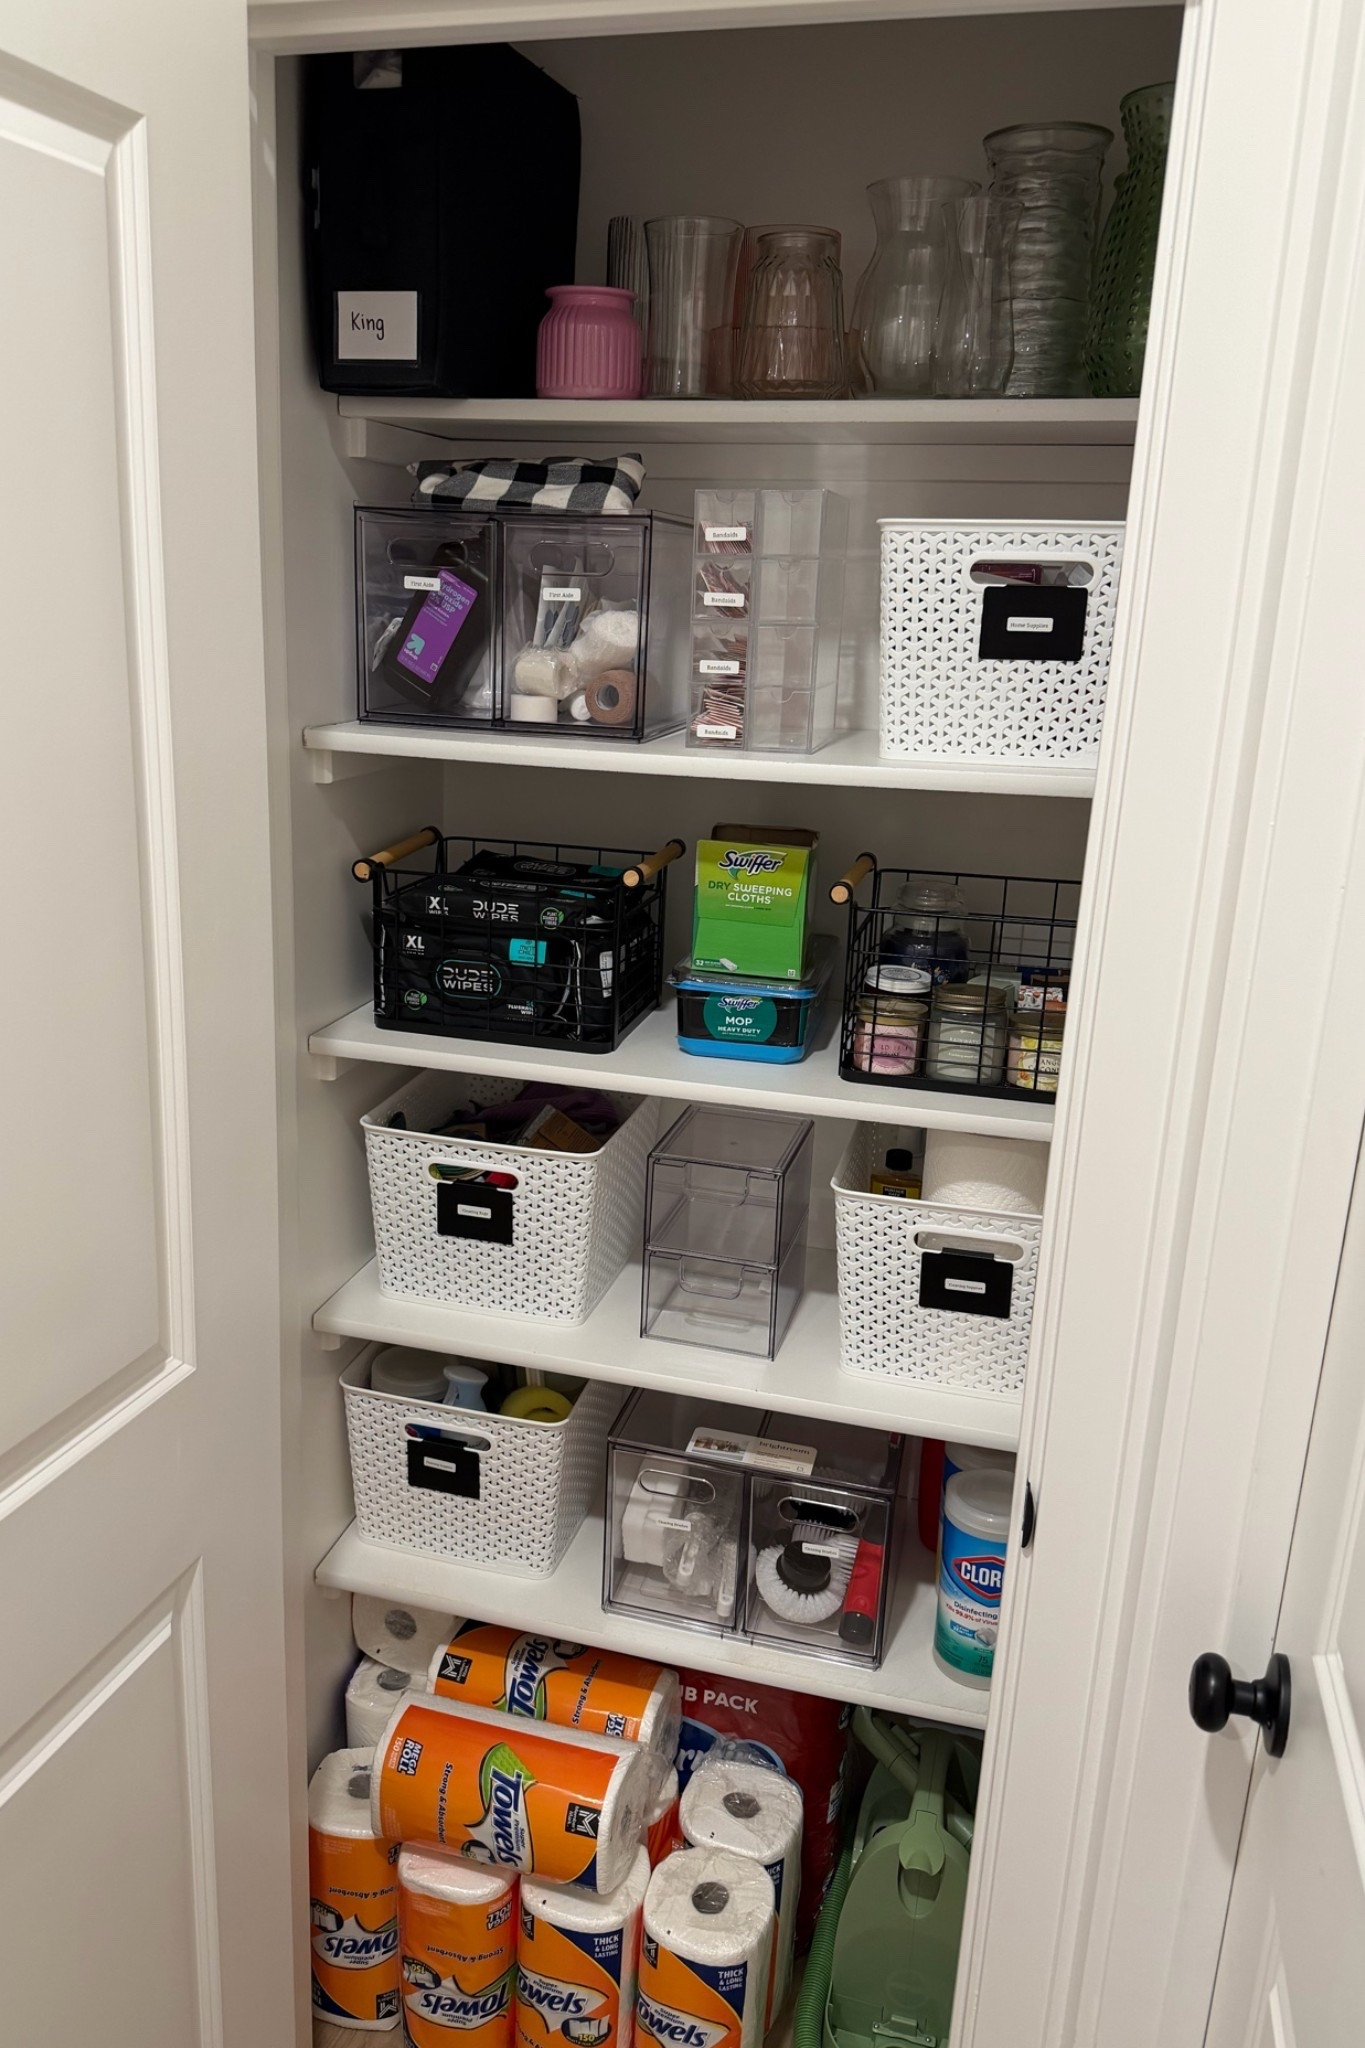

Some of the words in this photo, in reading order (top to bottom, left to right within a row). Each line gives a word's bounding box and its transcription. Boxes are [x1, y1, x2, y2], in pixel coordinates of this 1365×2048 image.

[351, 311, 385, 341] King
[439, 589, 463, 610] eroxide
[719, 850, 782, 875] Swiffer
[708, 880, 732, 891] DRY
[733, 883, 793, 898] SWEEPING
[727, 892, 772, 906] CLOTHS
[472, 900, 520, 915] DUDE
[406, 935, 426, 950] XL
[442, 966, 494, 983] DUDE
[442, 979, 494, 993] WIPES
[718, 996, 760, 1011] Swiffer
[725, 1016, 753, 1026] MOP
[742, 1027, 761, 1035] DUTY
[759, 1441, 810, 1456] brightroom
[953, 1601, 998, 1621] Disinfecting
[507, 1637, 550, 1719] Towels
[571, 1694, 587, 1725] Strong
[703, 1690, 760, 1715] PACK
[392, 1736, 404, 1752] 150
[398, 1739, 415, 1774] ROLL
[406, 1742, 422, 1775] MEGA
[439, 1762, 454, 1795] Strong
[489, 1765, 524, 1868] Towels
[329, 1886, 370, 1899] Absorbent
[593, 1934, 619, 1946] THICK
[427, 1945, 468, 1963] Absorbent
[478, 1946, 504, 1963] Strong
[594, 1949, 619, 1959] LASTING
[601, 1943, 619, 1953] LONG
[411, 1963, 426, 1975] 150
[718, 1967, 744, 1980] THICK
[718, 1982, 743, 1992] LASTING
[725, 1976, 744, 1986] LONG
[420, 1979, 510, 2020] Towels
[578, 2034, 596, 2042] 150
